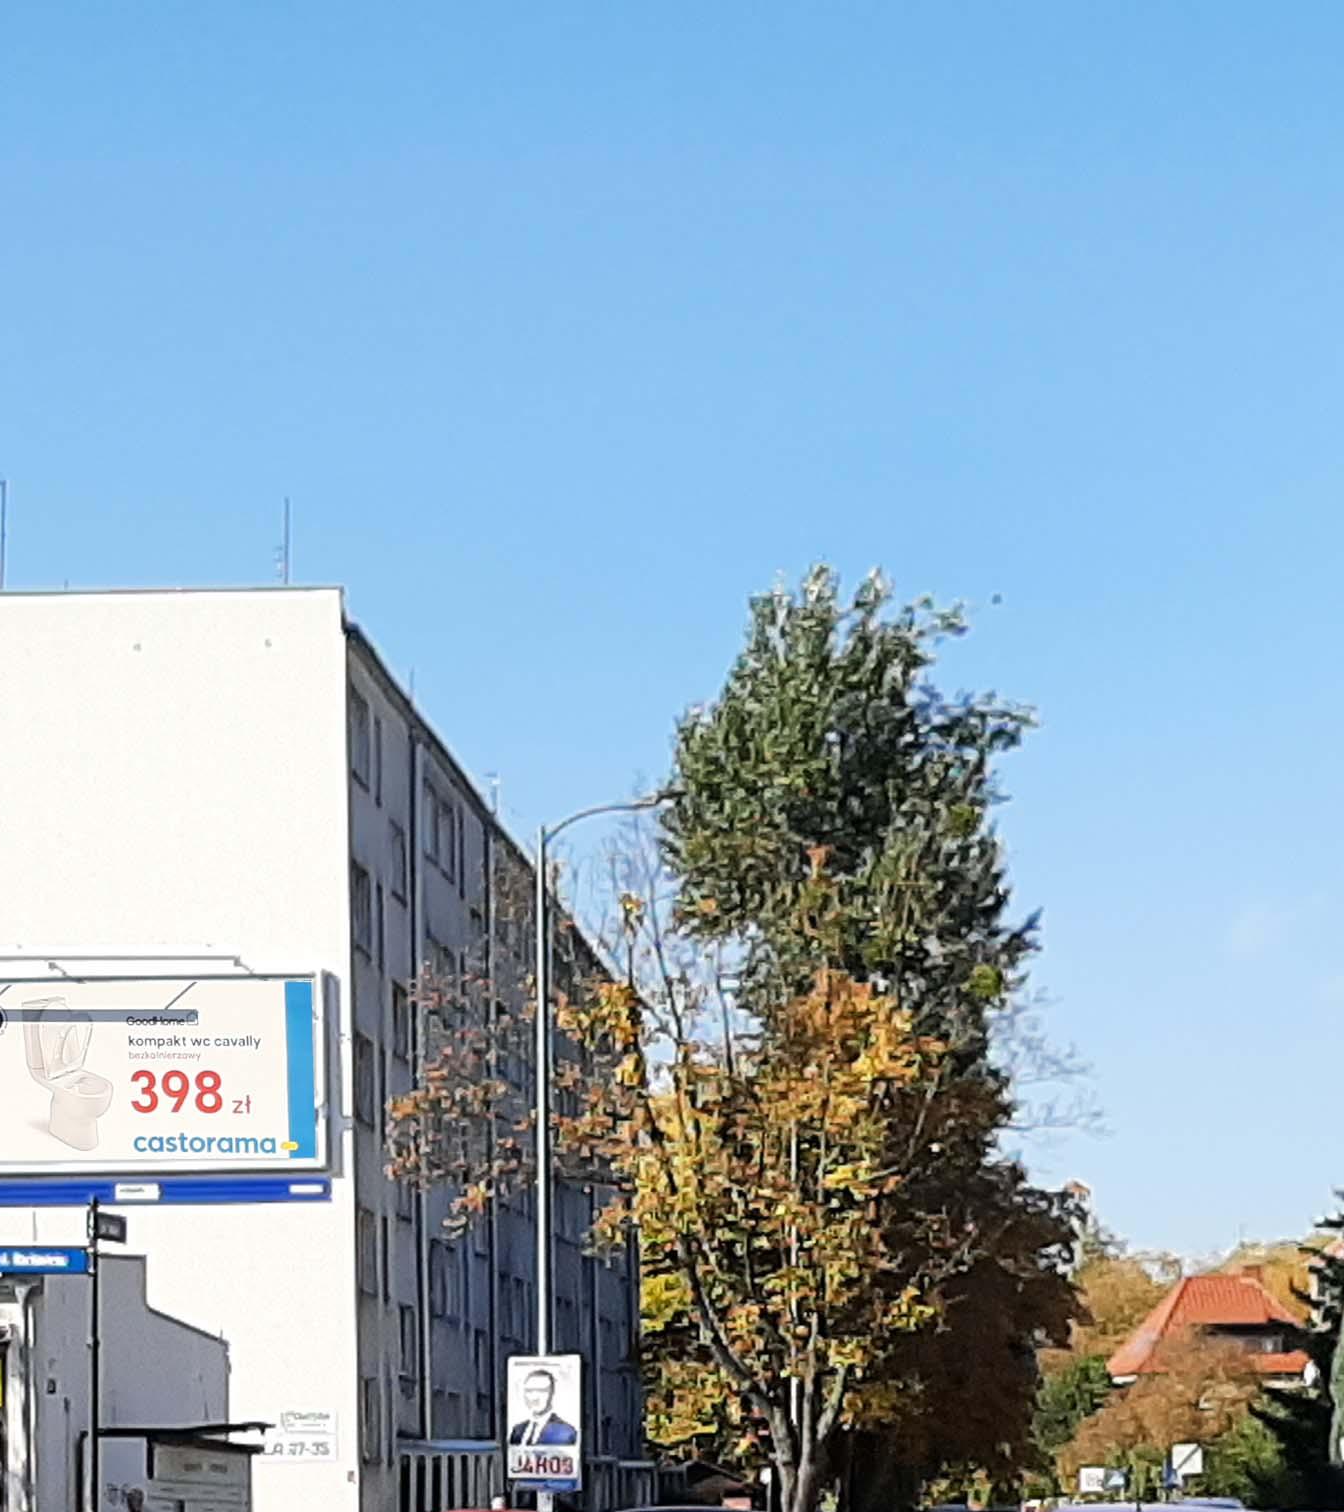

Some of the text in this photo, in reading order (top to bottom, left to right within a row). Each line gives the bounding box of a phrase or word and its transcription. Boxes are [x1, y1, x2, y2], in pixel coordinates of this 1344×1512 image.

[126, 1016, 185, 1026] GoodHome
[128, 1035, 261, 1050] kompakt wc cavally
[130, 1070, 252, 1114] 398 zł
[133, 1133, 277, 1154] castorama
